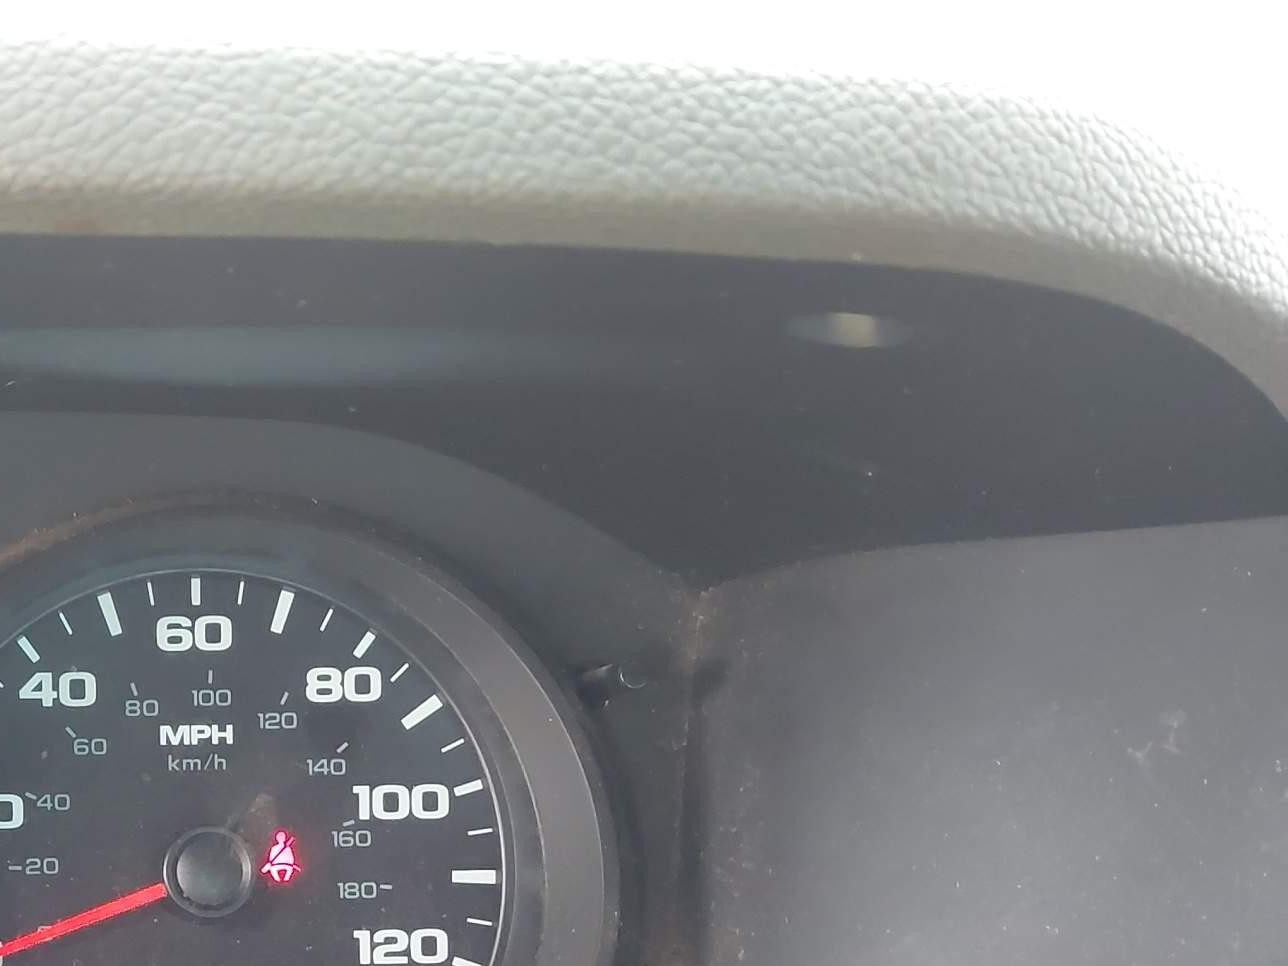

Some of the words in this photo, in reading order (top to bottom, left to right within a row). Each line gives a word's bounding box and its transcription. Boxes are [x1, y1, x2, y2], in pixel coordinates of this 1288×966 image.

[156, 615, 233, 652] 60
[19, 671, 97, 708] 40
[305, 666, 382, 704] 80
[191, 688, 232, 708] 100
[125, 699, 159, 718] 80
[257, 711, 298, 730] 120
[159, 724, 234, 746] MPH
[73, 738, 107, 756] 60
[167, 753, 227, 771] km/h
[307, 758, 347, 776] 140
[36, 793, 71, 811] 40
[352, 784, 450, 820] 100
[332, 830, 372, 848] 160
[25, 856, 59, 875] 20
[337, 881, 378, 899] 180
[353, 928, 450, 965] 120
